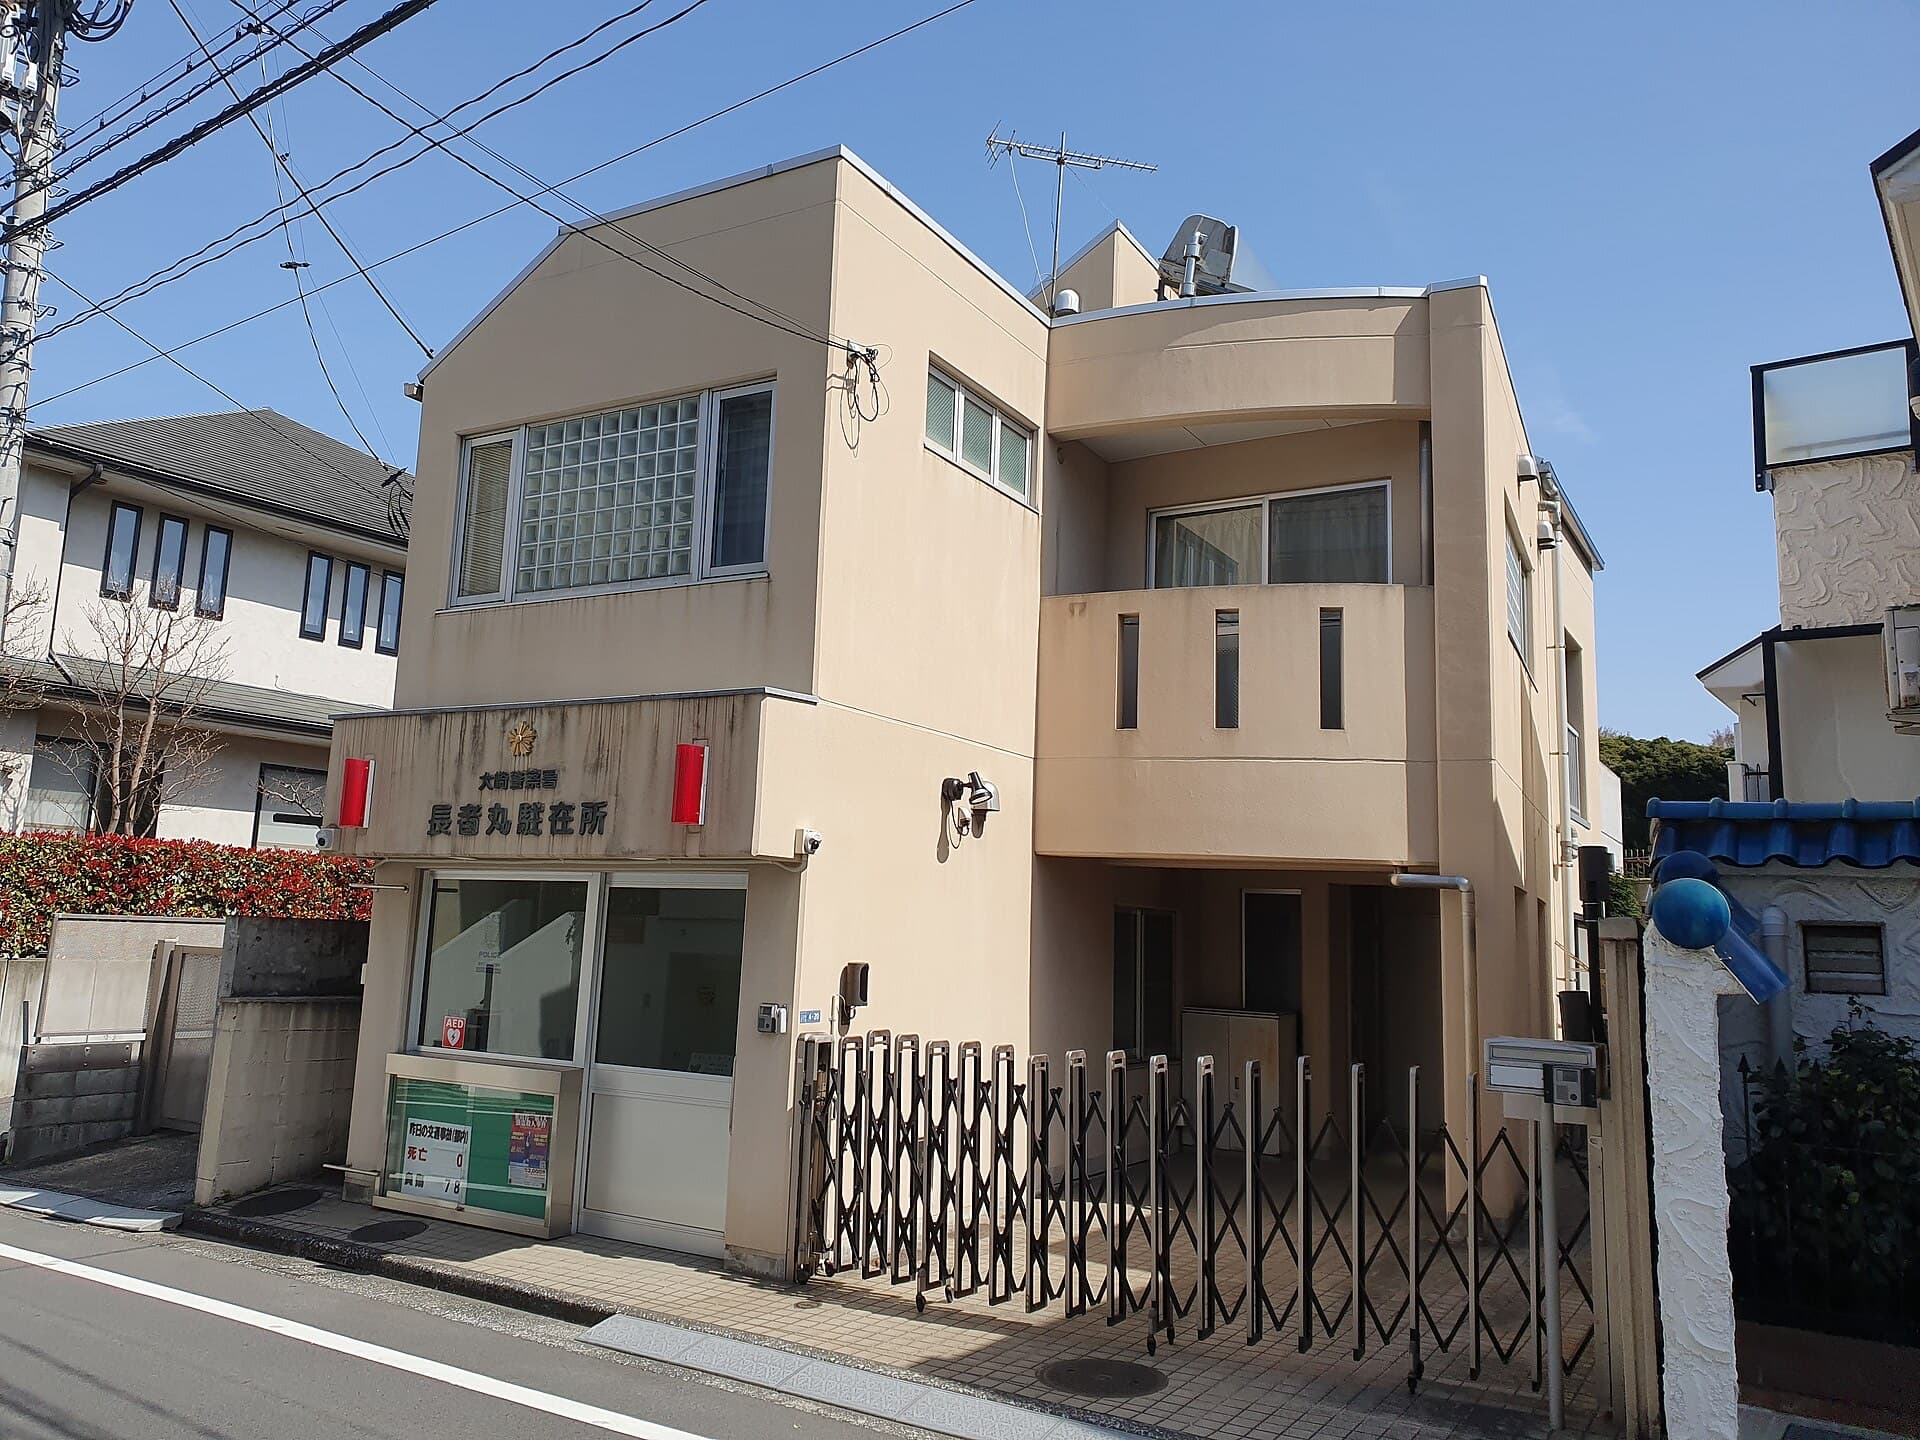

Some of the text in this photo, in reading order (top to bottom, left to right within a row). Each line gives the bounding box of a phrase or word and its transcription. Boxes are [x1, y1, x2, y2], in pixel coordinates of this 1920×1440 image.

[478, 769, 558, 790] 大崎警察署
[427, 801, 607, 837] 長者丸駐在所
[446, 1018, 464, 1029] AED
[407, 1146, 427, 1161] 死亡
[456, 1153, 463, 1167] 0
